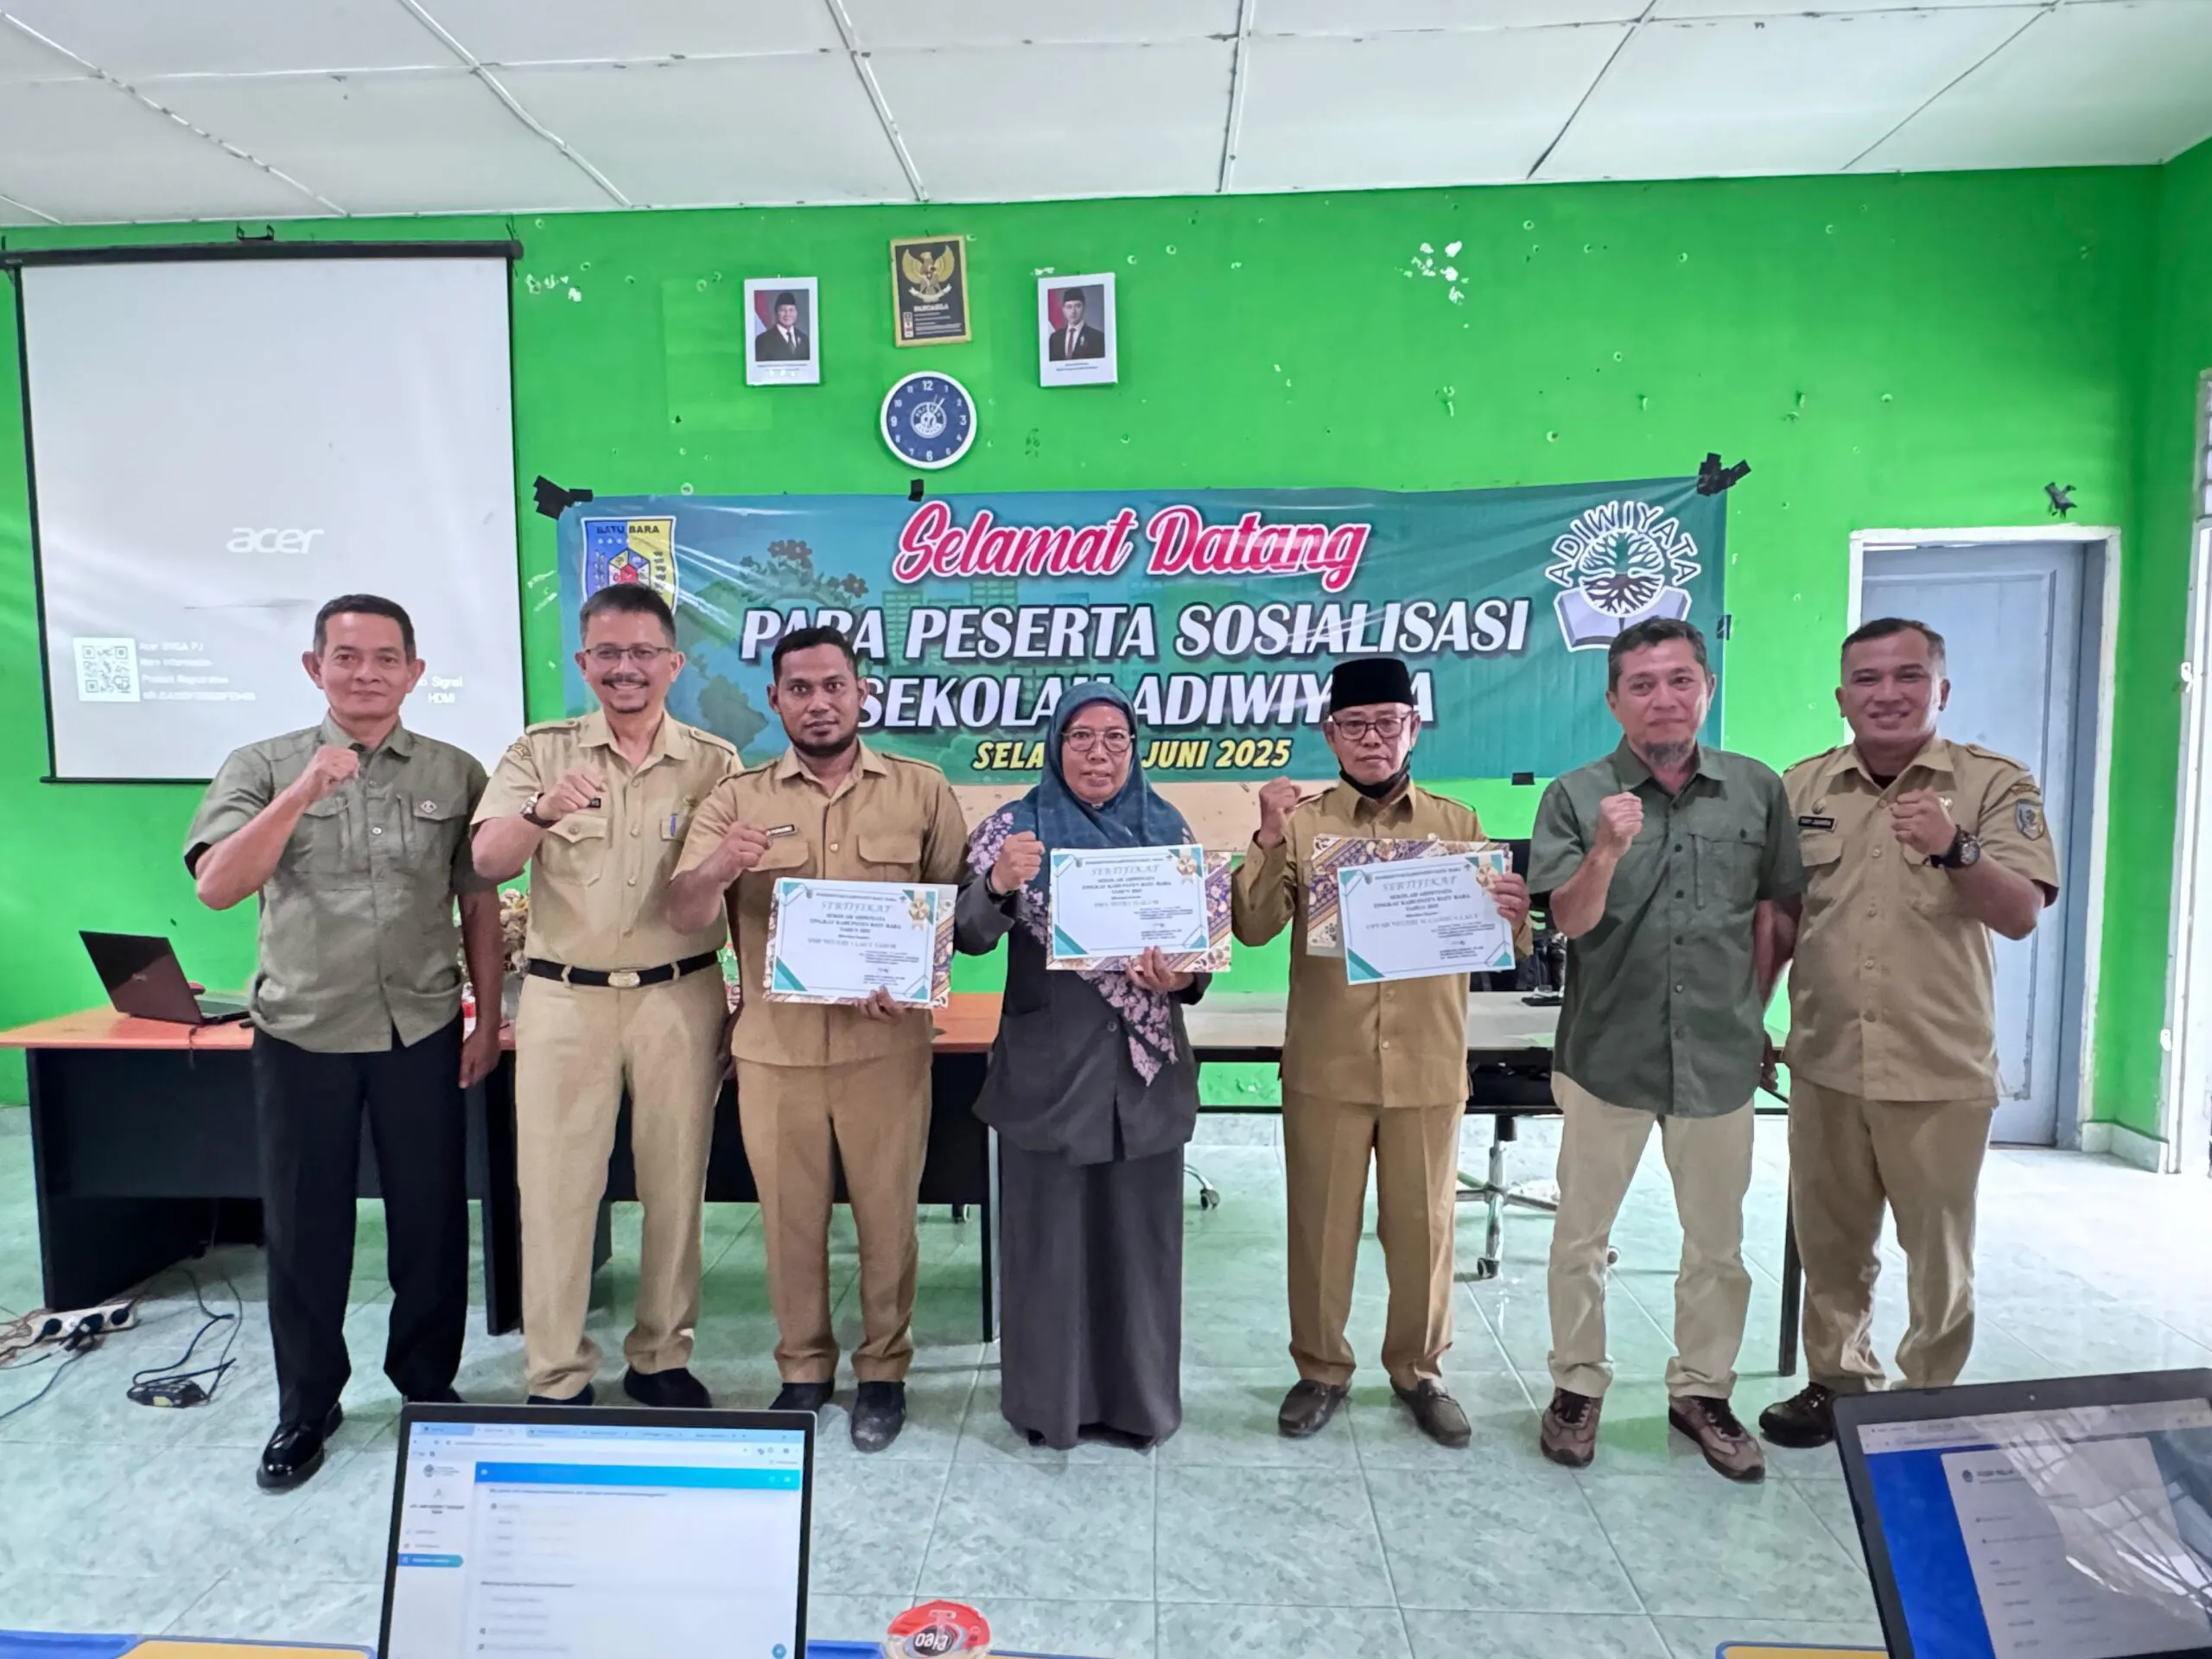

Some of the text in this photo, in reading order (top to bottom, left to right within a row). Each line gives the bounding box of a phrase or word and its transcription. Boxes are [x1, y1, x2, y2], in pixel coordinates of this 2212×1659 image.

[922, 380, 933, 391] 12
[944, 385, 949, 393] 1
[957, 398, 963, 407] 2
[890, 416, 898, 427] 9
[959, 415, 967, 426] 3
[925, 450, 933, 461] 6
[596, 525, 625, 534] BATU
[226, 527, 325, 554] acer
[1546, 501, 1701, 588] ADIWIYATA
[893, 501, 1371, 592] Selamat Datang
[906, 607, 1155, 658] PESERTA
[1176, 601, 1529, 656] SOSIALISASI
[858, 671, 1434, 727] SEKOLA ADIWIYA
[974, 739, 1292, 770] SELA JUNI 2025
